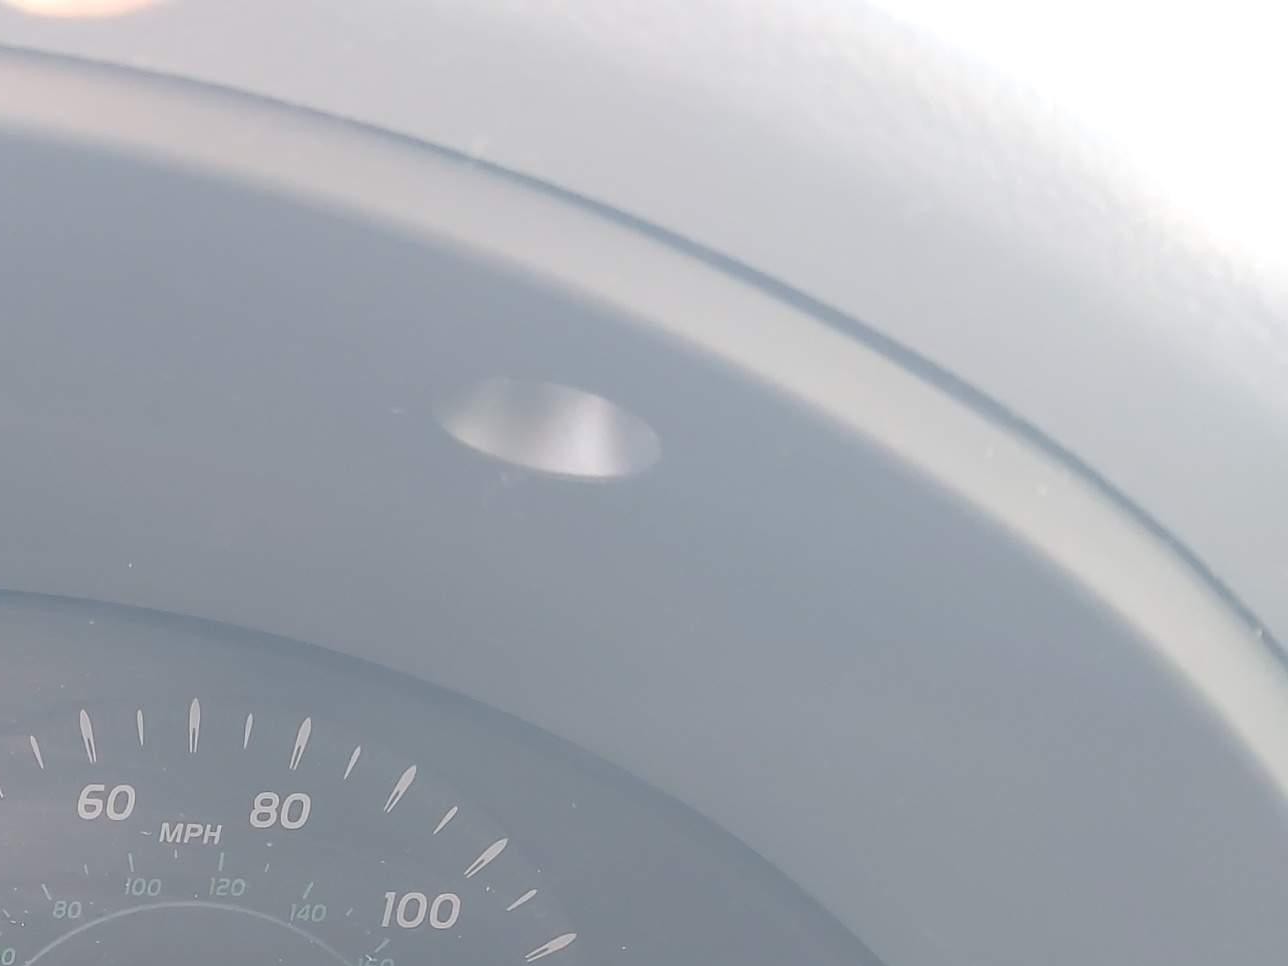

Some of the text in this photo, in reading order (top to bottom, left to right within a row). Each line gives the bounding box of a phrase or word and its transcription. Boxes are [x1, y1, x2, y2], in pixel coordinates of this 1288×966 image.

[76, 784, 136, 822] 60
[249, 791, 311, 830] 80
[159, 822, 222, 846] MPH
[124, 877, 162, 897] 100
[209, 877, 246, 897] 120
[52, 900, 82, 920] 80
[289, 903, 327, 923] 140
[381, 891, 461, 930] 100
